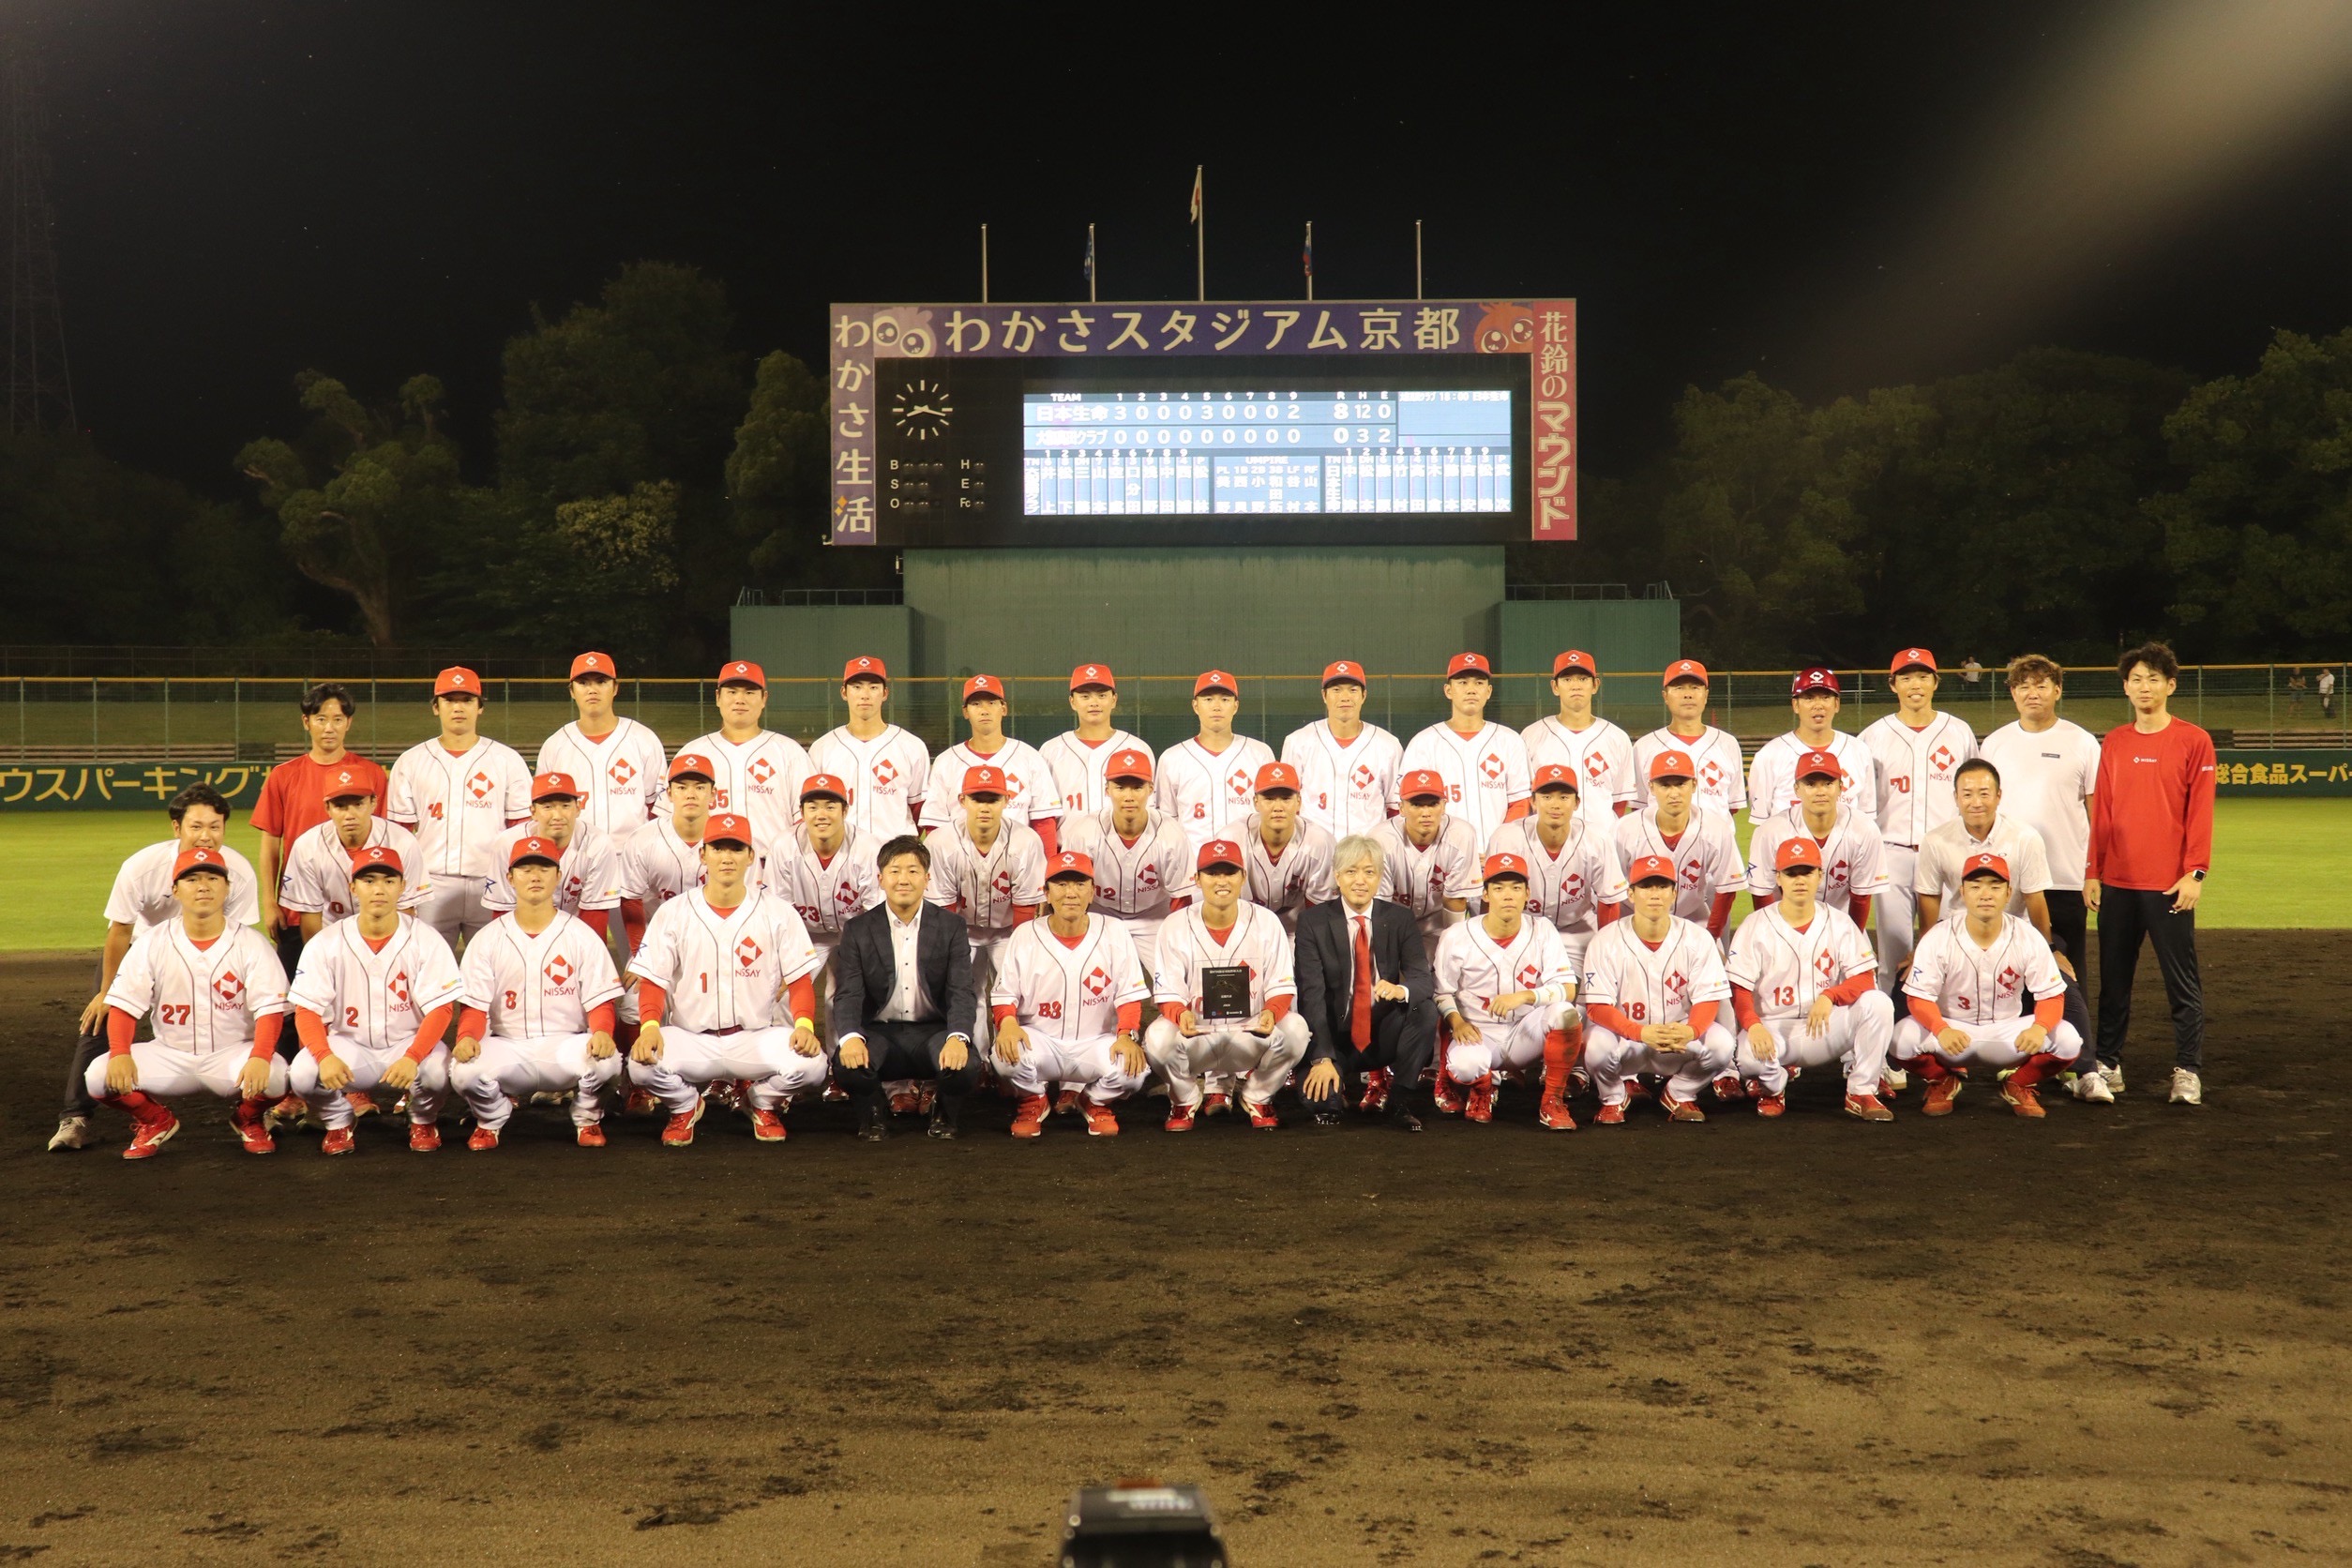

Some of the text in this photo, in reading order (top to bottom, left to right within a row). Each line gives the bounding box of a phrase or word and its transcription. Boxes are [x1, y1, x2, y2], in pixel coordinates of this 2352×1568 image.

[944, 308, 1461, 353] わかさスタジアム京都
[1050, 393, 1081, 402] TEAM
[1138, 393, 1145, 401] 2
[1203, 392, 1211, 402] 5
[1225, 392, 1232, 400] 6
[1268, 392, 1275, 400] 8
[1289, 392, 1297, 400] 9
[1380, 391, 1388, 400] E
[1036, 403, 1391, 421] 日本生命 3 0 0 0 3 0 0 0 2 8 12 0
[835, 315, 874, 533] わかさ生活
[1537, 311, 1571, 530] 花鈴のマウンド
[1114, 430, 1126, 444] 0
[1136, 430, 1148, 444] 0
[1158, 430, 1170, 444] 0
[1180, 430, 1192, 444] 0
[1201, 430, 1214, 444] 0
[1223, 430, 1235, 444] 0
[1244, 430, 1257, 443] 0
[1266, 430, 1278, 443] 0
[1288, 429, 1300, 443] 0
[1334, 428, 1349, 444] 0
[1357, 429, 1368, 443] 3
[1379, 429, 1390, 442] 2
[890, 460, 898, 470] B
[961, 460, 970, 469] H
[891, 479, 898, 489] S
[961, 479, 970, 489] E
[891, 498, 899, 508] O
[960, 498, 971, 507] Fc
[2215, 762, 2352, 785] 総合食品スーパ
[0, 766, 271, 802] ウスパーキング
[611, 787, 637, 795] NISSAY
[748, 785, 774, 795] NISSAY
[1482, 780, 1505, 789] NISSAY
[1891, 776, 1910, 793] 70
[466, 800, 492, 808] NISSAY
[1066, 793, 1082, 810] 11
[1194, 803, 1205, 820] 6
[1095, 885, 1116, 901] 12
[700, 972, 708, 993] 1
[505, 990, 517, 1010] 8
[544, 988, 576, 997] NISSAY
[1773, 987, 1794, 1006] 13
[1083, 996, 1110, 1006] NISSAY
[1958, 996, 1971, 1010] 3
[161, 1004, 191, 1025] 27
[346, 1007, 359, 1028] 2
[1622, 1003, 1645, 1020] 18
